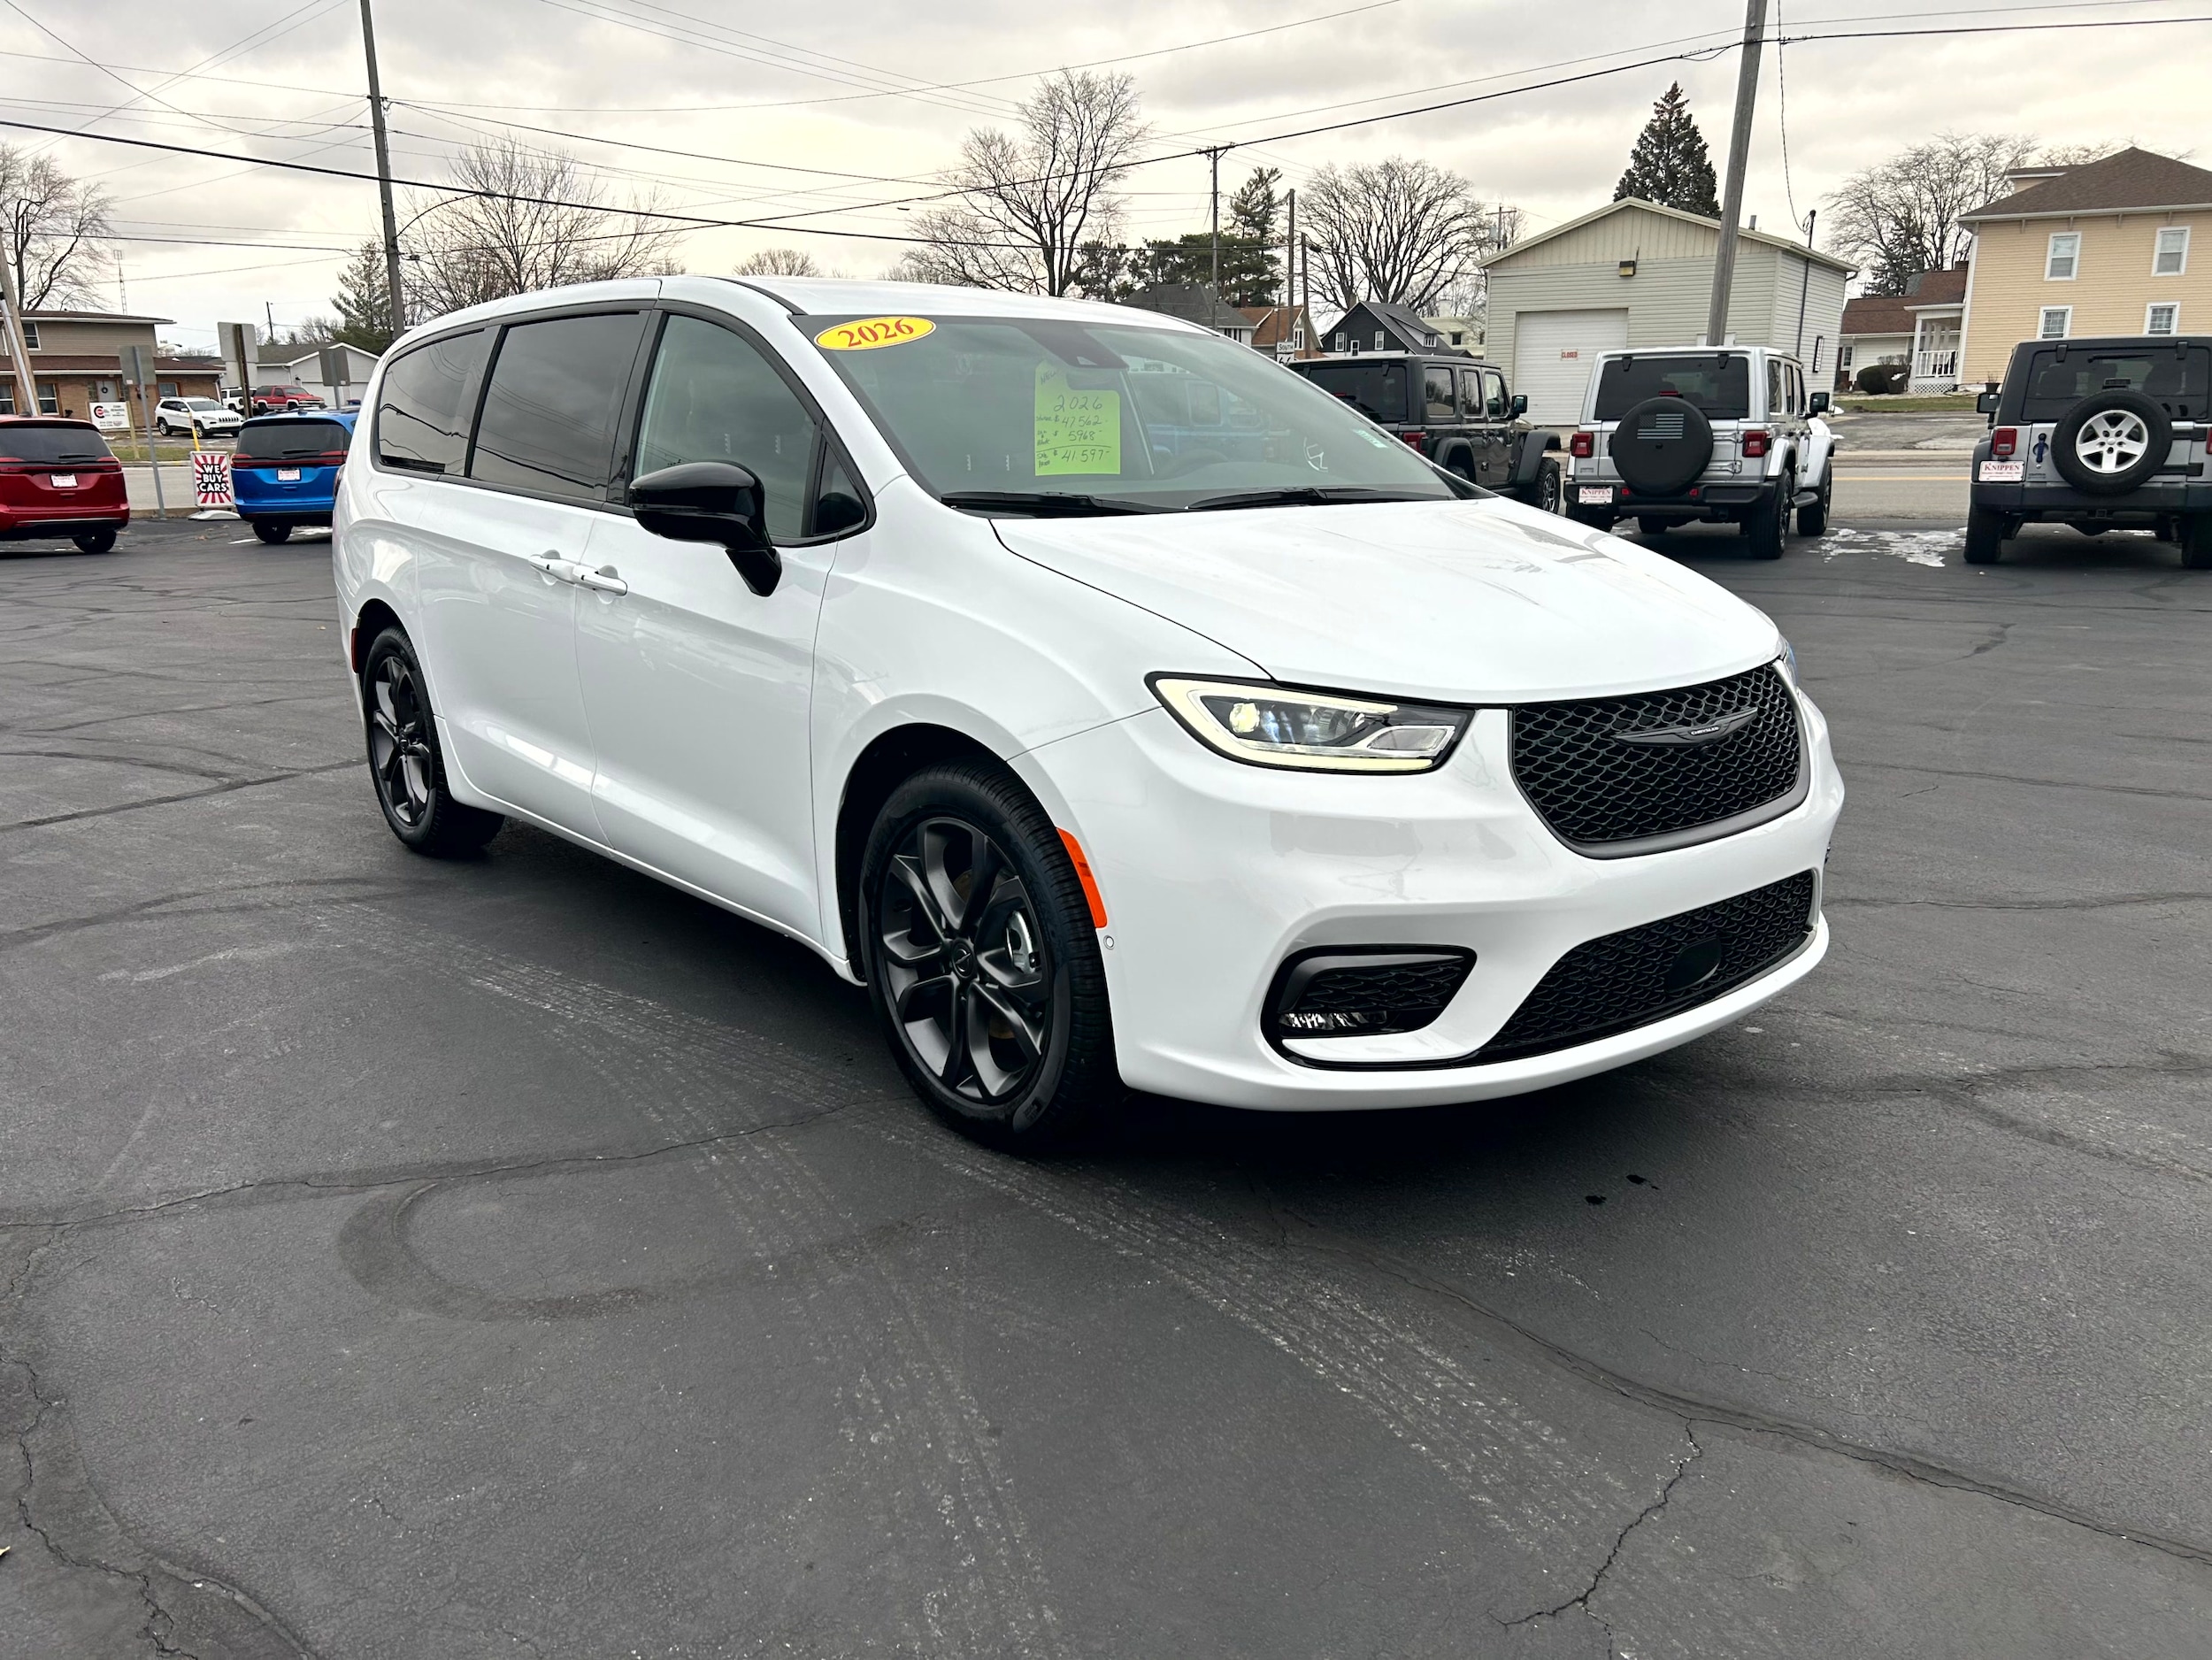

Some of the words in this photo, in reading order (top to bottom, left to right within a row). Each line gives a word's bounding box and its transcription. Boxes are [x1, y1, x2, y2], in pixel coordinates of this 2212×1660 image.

[837, 319, 914, 347] 2026
[1053, 395, 1102, 412] 2026
[204, 465, 220, 473] WE
[203, 473, 223, 483] BUY
[199, 482, 227, 492] CARS
